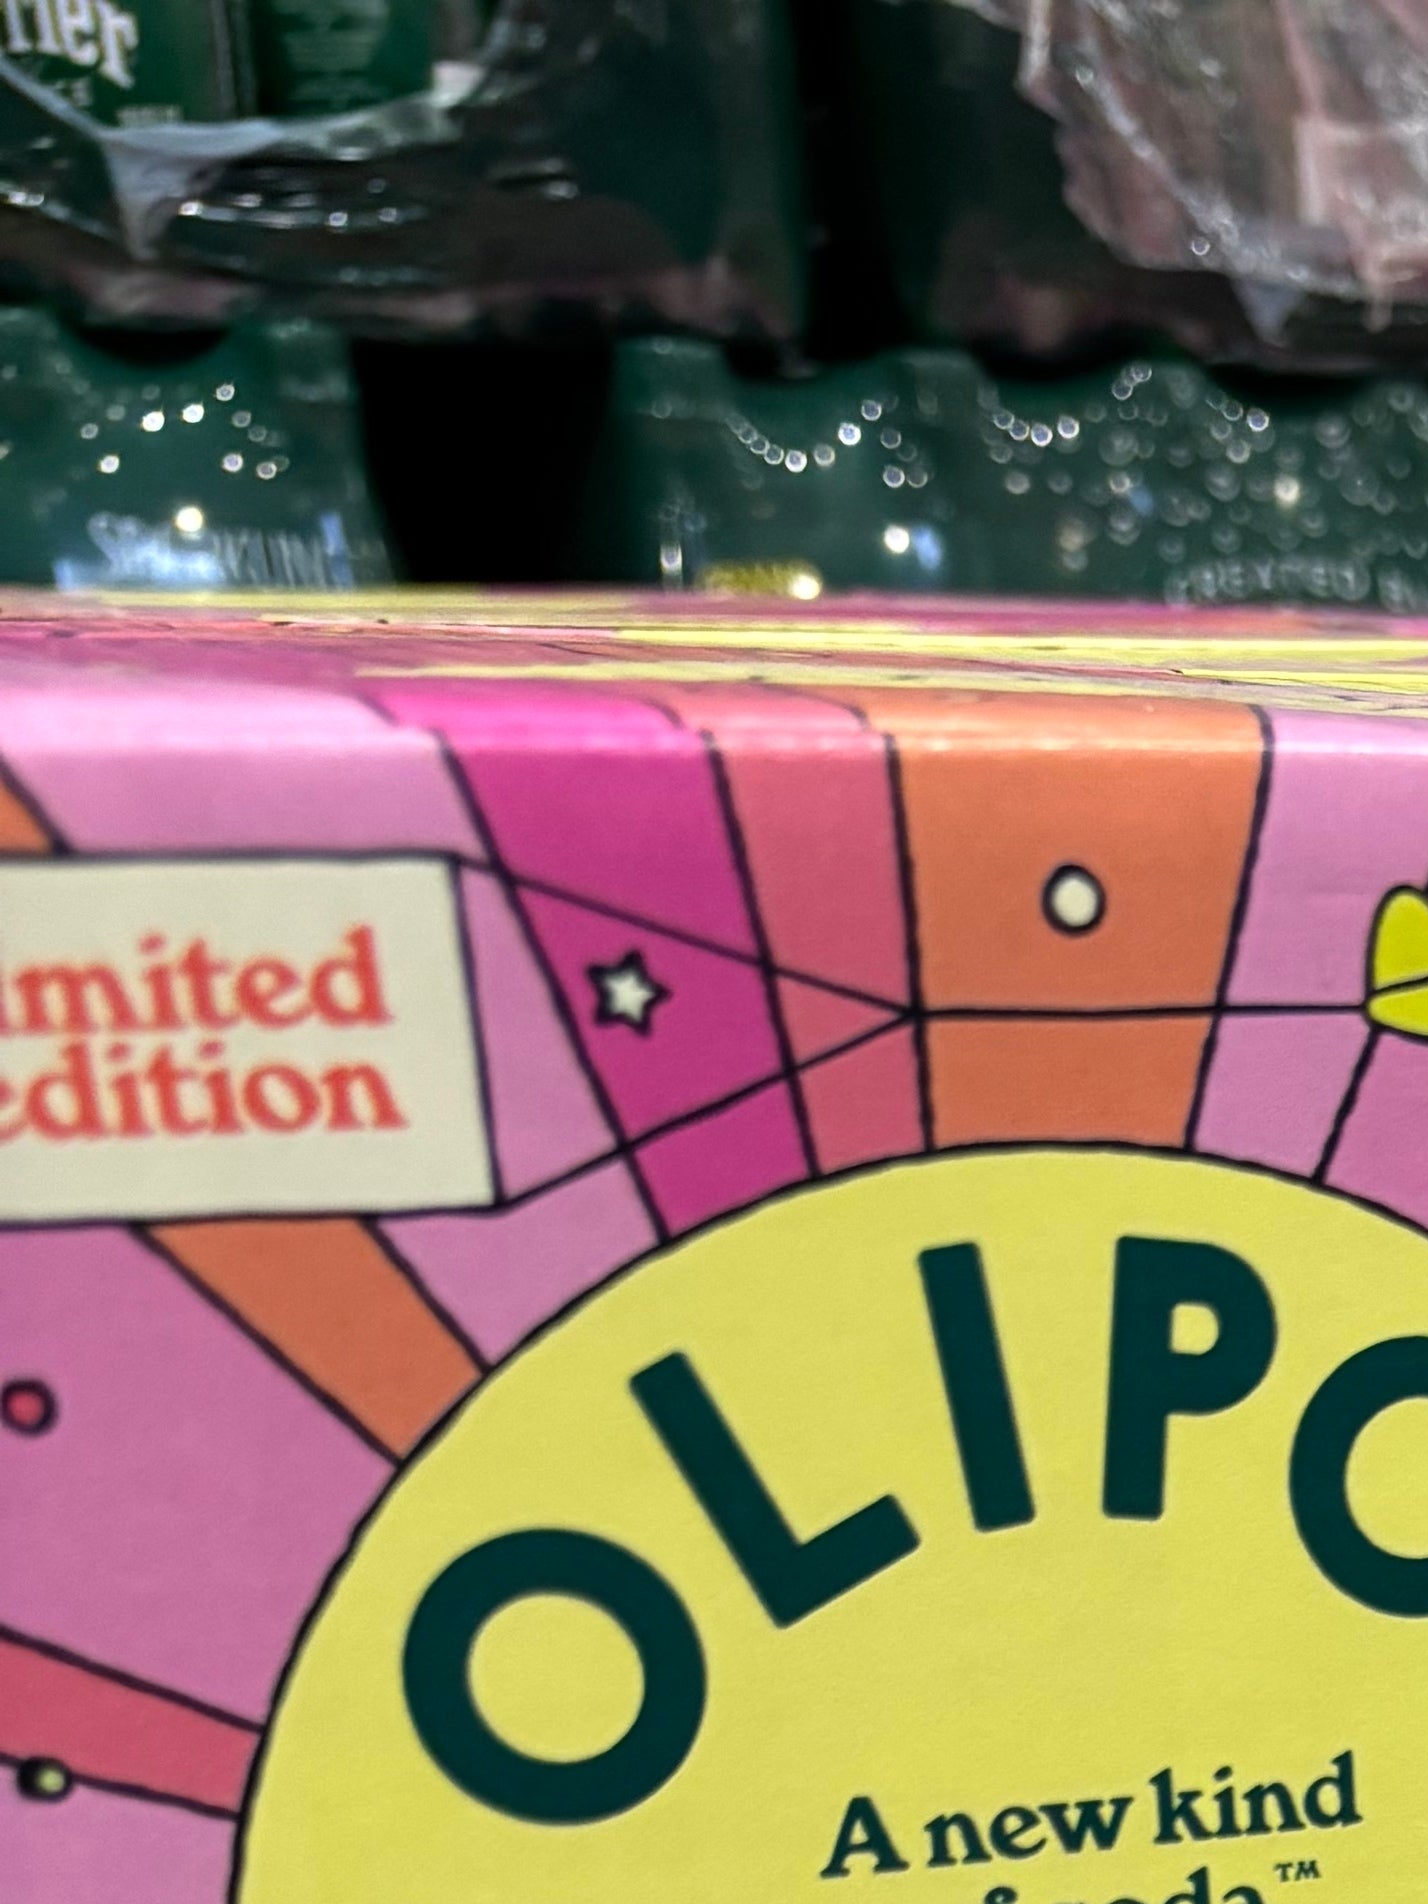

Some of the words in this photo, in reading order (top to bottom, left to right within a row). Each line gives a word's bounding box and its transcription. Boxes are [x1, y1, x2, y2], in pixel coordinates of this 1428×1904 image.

[0, 924, 393, 1035] mited
[820, 1797, 907, 1880] A
[925, 1797, 1135, 1872] new
[1148, 1752, 1362, 1848] kind
